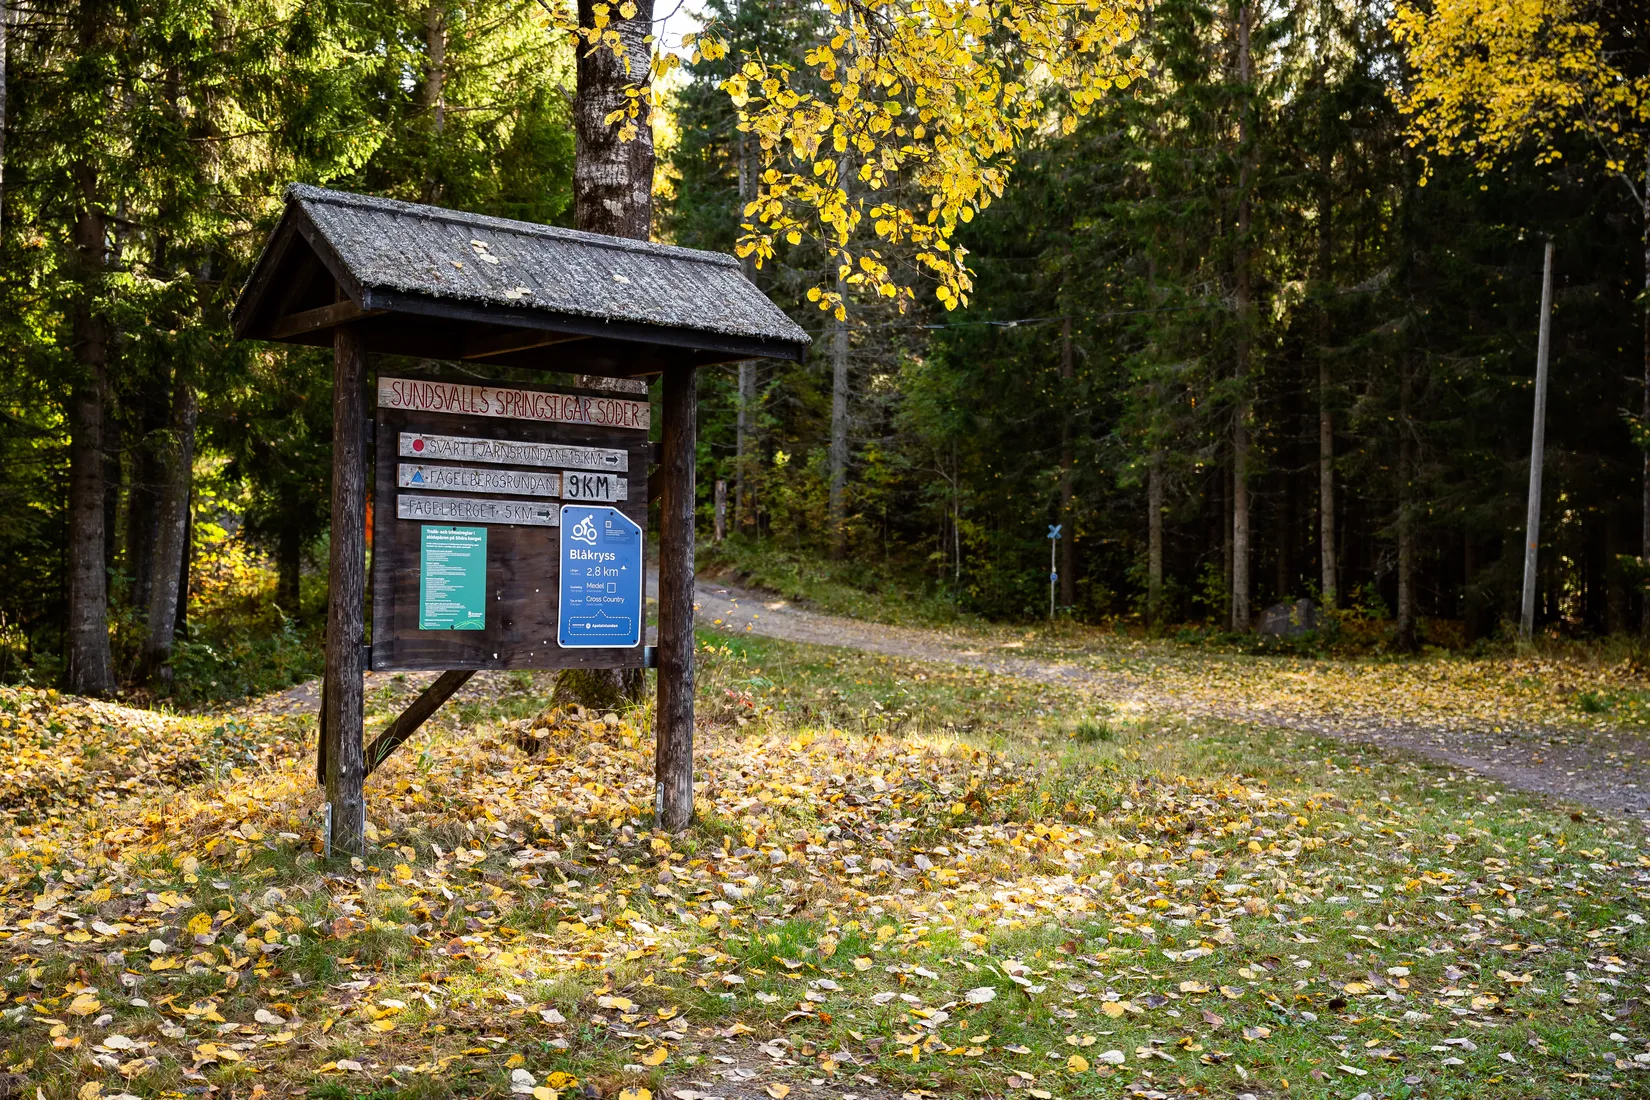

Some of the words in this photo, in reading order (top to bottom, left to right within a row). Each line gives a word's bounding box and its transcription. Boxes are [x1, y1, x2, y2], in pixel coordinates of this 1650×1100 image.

[391, 381, 489, 413] SUNDSVALLS
[495, 390, 591, 422] SPRINGSTIGAR
[597, 399, 639, 426] SÖDER
[569, 549, 616, 563] Blåkryss
[586, 566, 601, 577] 2,8
[603, 566, 619, 577] km
[586, 582, 605, 590] Medel
[585, 595, 602, 603] Cross
[602, 595, 625, 604] Country
